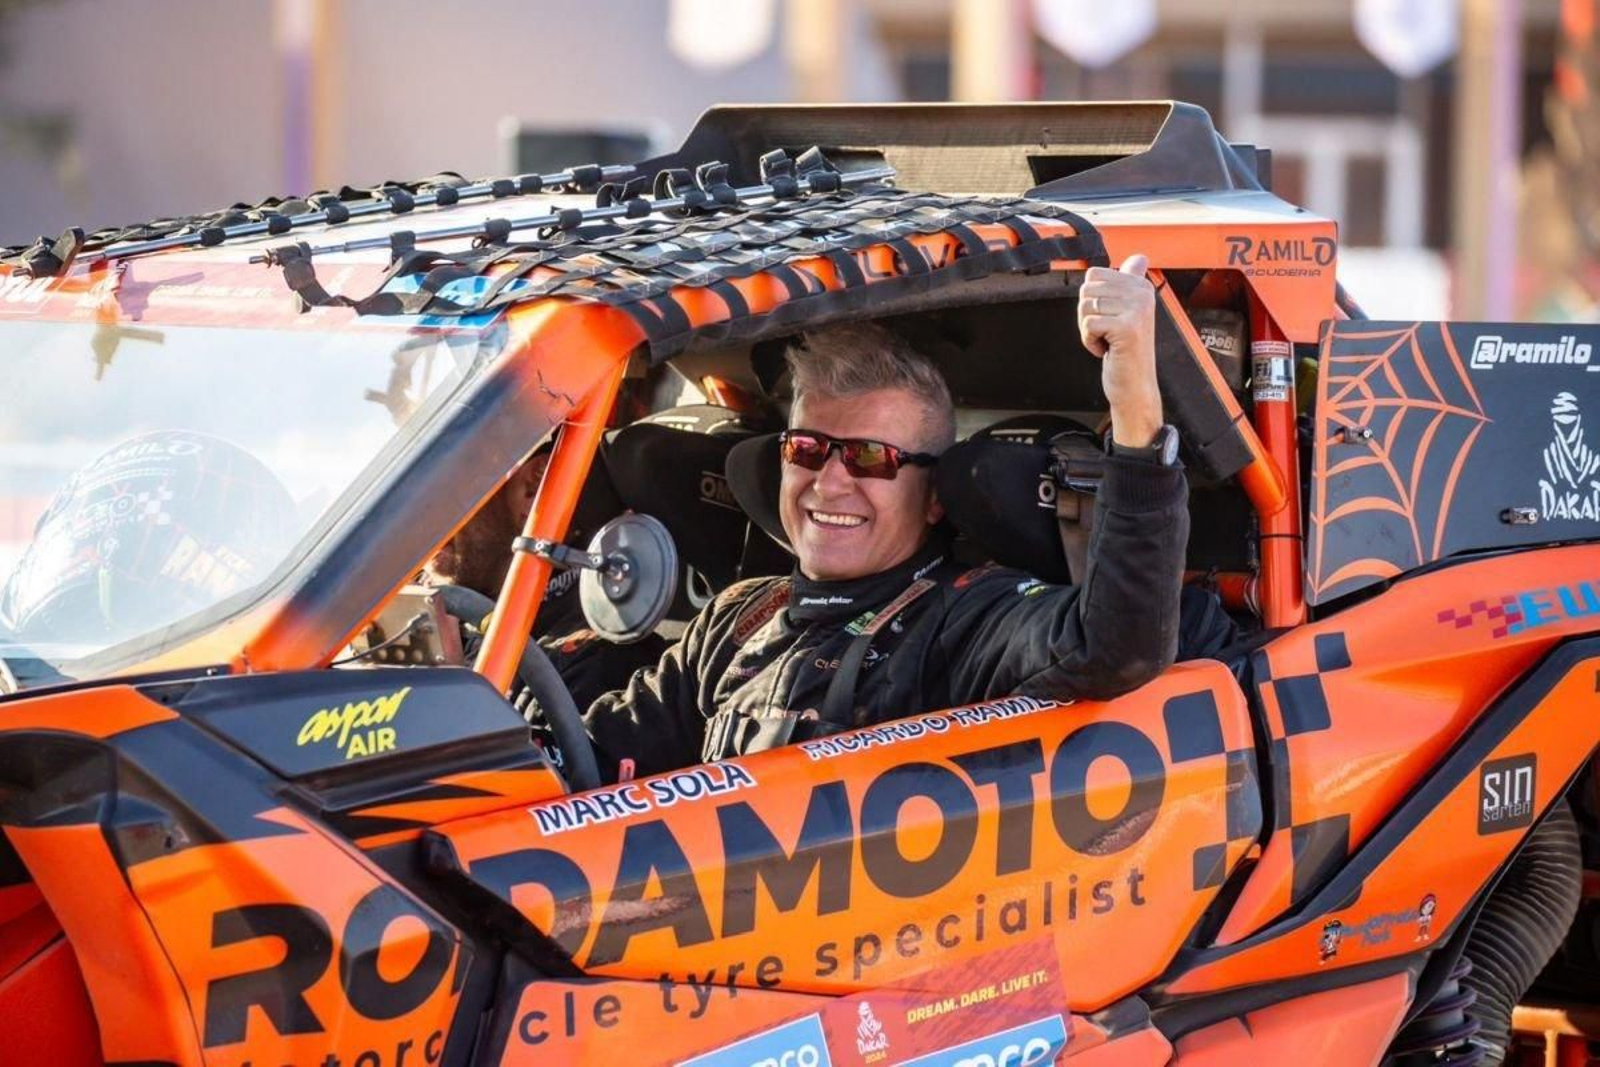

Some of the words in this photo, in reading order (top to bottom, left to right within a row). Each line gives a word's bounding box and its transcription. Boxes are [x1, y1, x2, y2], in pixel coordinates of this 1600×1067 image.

[1225, 236, 1337, 266] RAMILO
[1245, 268, 1322, 277] SCUDERIA
[346, 727, 396, 759] AIR
[801, 715, 953, 760] RICARDO
[948, 695, 1075, 727] RAMIL
[533, 784, 651, 836] MARC
[658, 952, 784, 1019] tyre
[815, 865, 1147, 980] specialist
[907, 998, 958, 1024] DREAM.
[959, 985, 1000, 1008] DARE.
[1001, 974, 1030, 995] LIVE
[1032, 970, 1048, 986] IT.
[856, 1033, 890, 1056] DAKAR
